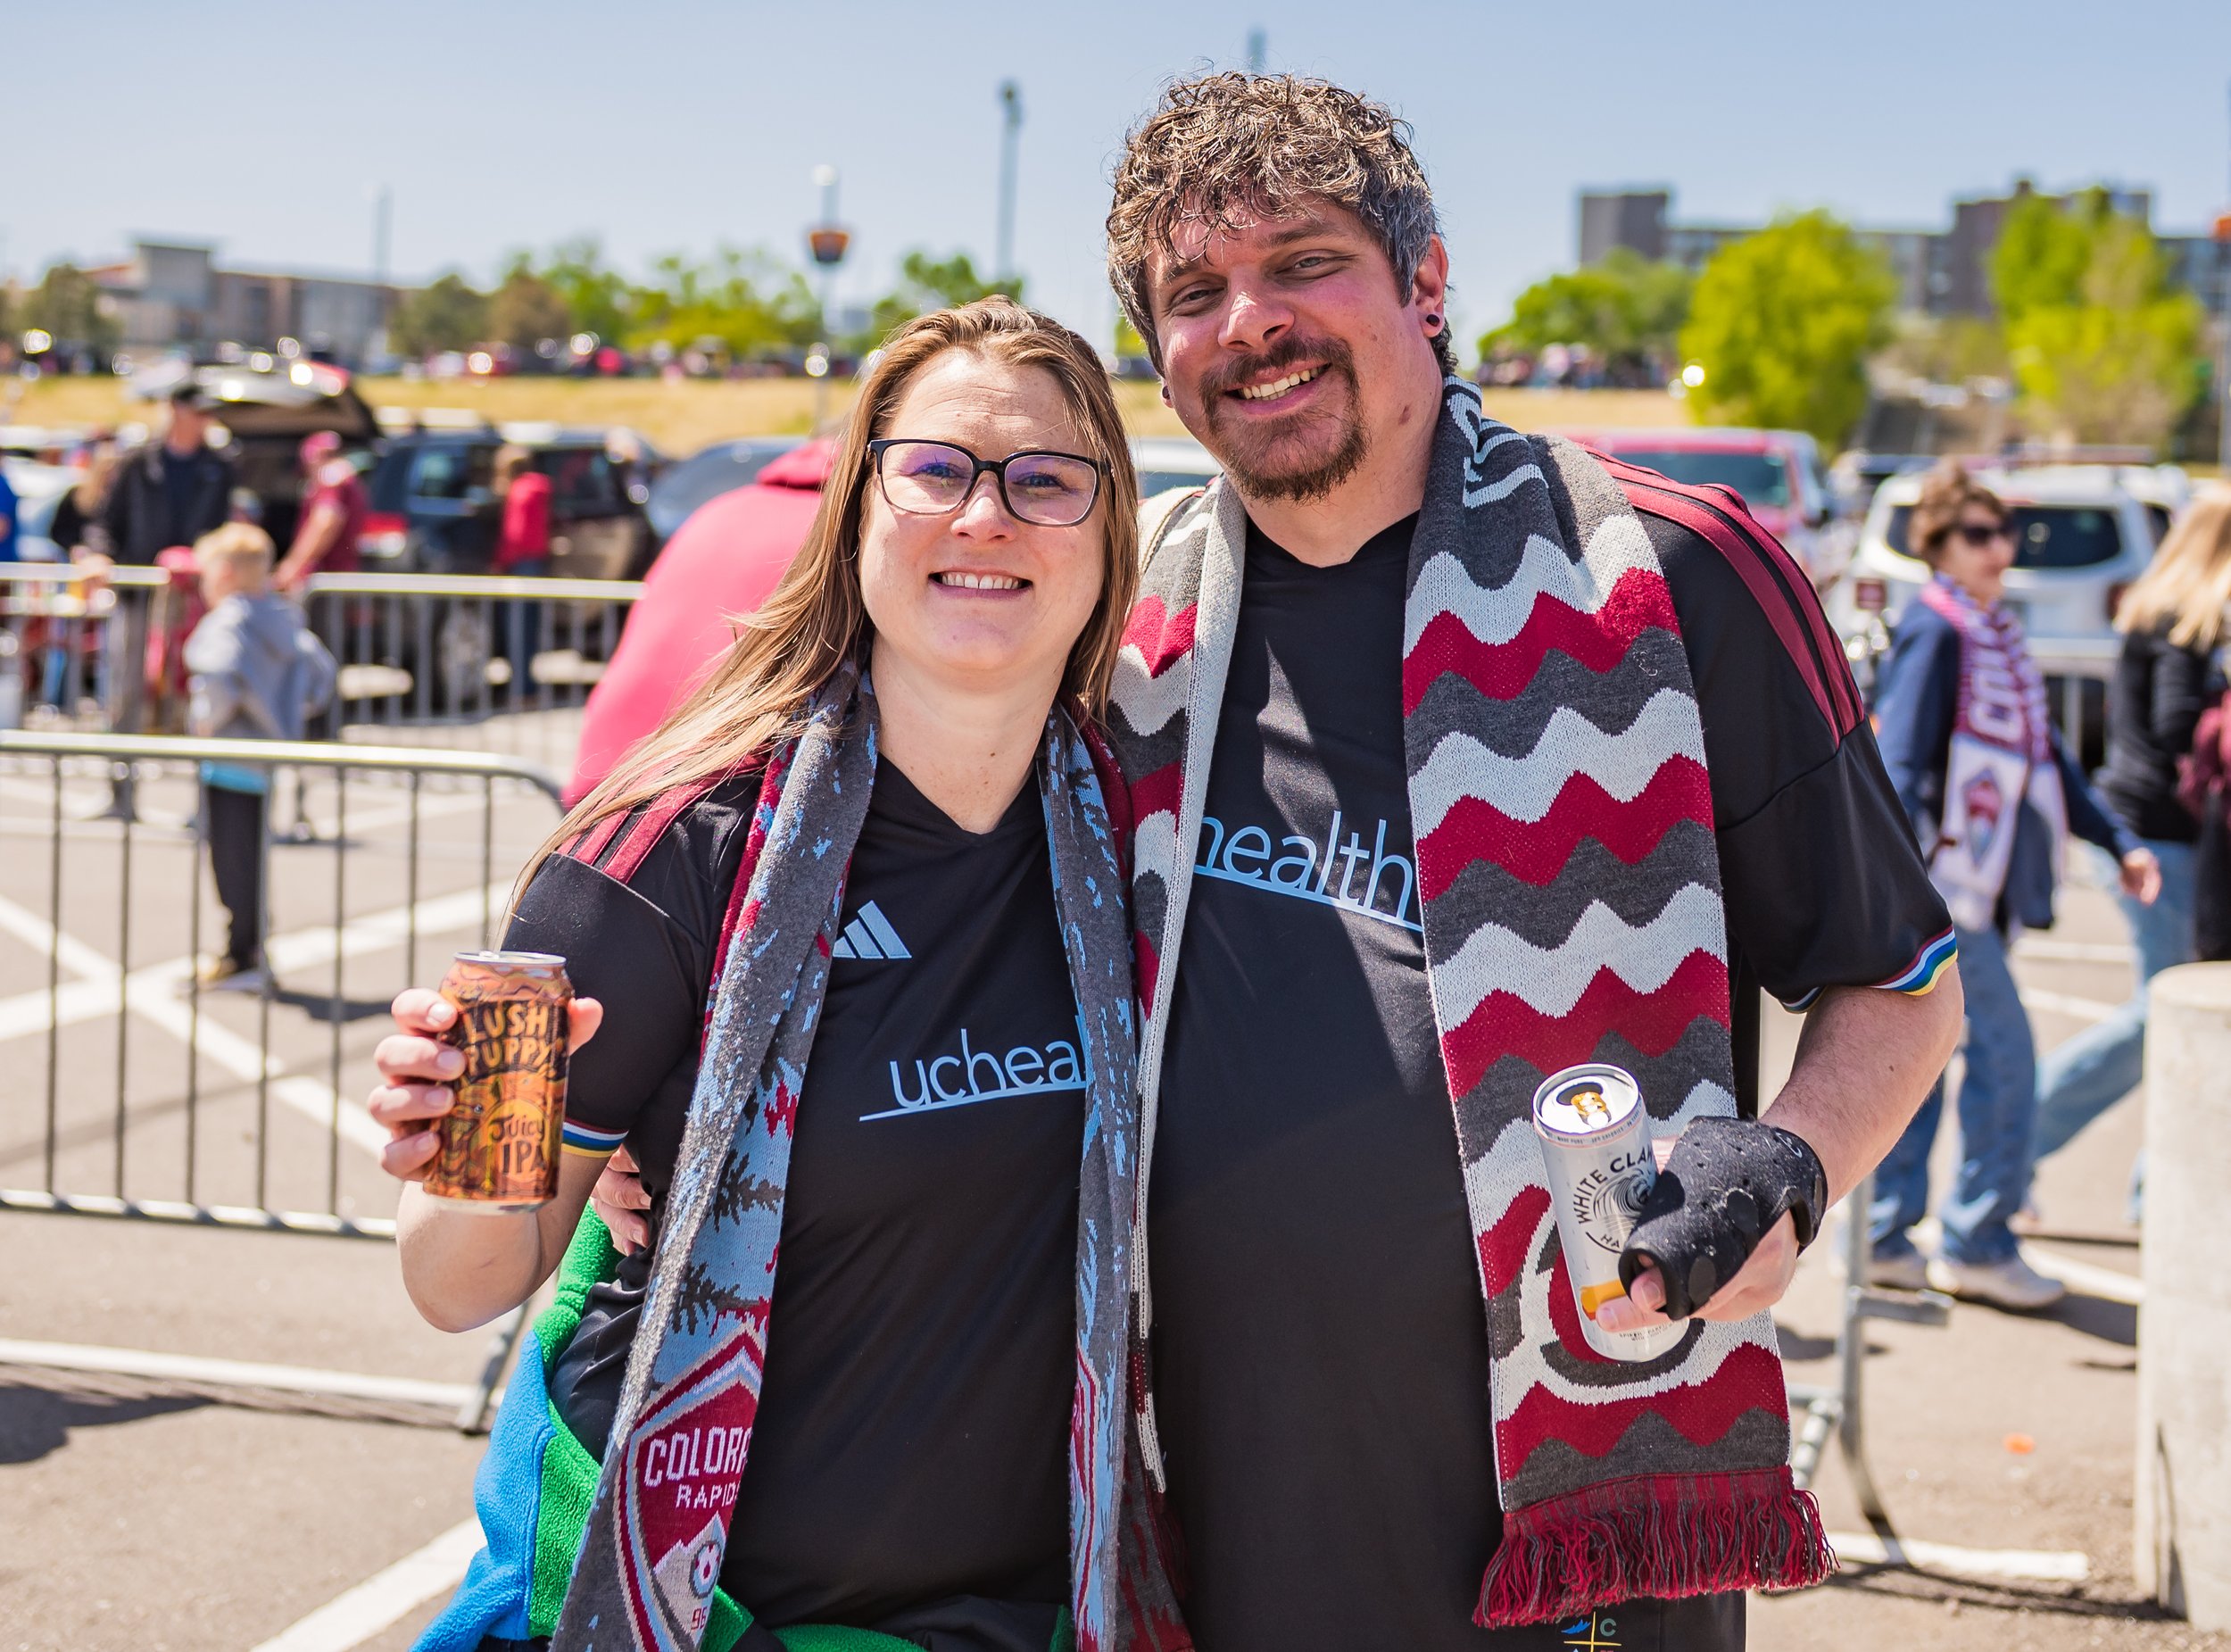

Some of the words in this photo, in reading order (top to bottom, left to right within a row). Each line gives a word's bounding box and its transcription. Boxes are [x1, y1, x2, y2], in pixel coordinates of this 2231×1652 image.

[462, 1000, 549, 1043] LUSH
[464, 1036, 552, 1076] PUPPY
[490, 1114, 545, 1142] Juicy
[503, 1140, 546, 1175] IPA
[1573, 1169, 1608, 1224] WHITE
[1600, 1618, 1617, 1637] C
